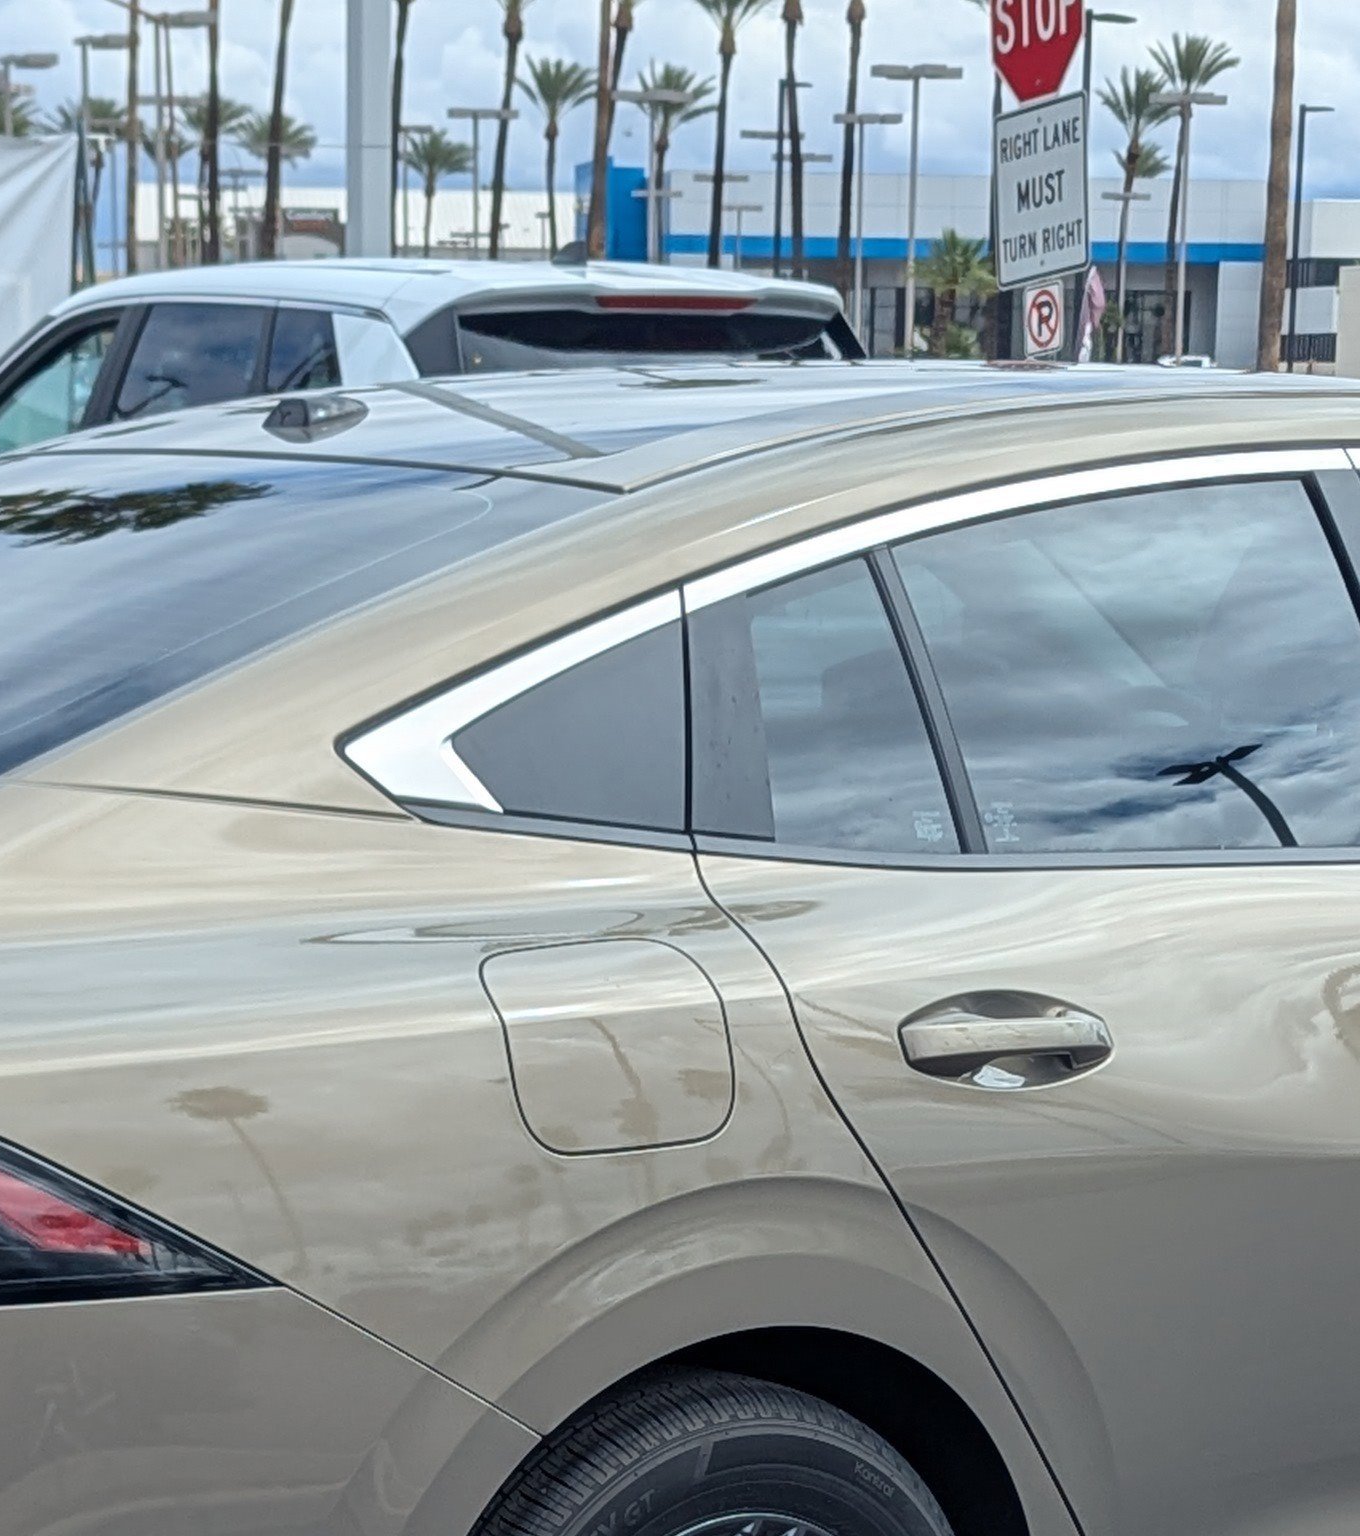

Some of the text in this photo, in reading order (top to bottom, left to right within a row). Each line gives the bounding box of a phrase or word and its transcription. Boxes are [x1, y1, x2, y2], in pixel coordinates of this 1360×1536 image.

[996, 0, 1076, 54] STOP
[1000, 116, 1080, 163] RIGHT LANE
[1017, 169, 1065, 213] MUST
[1002, 219, 1082, 264] TURN RIGHT
